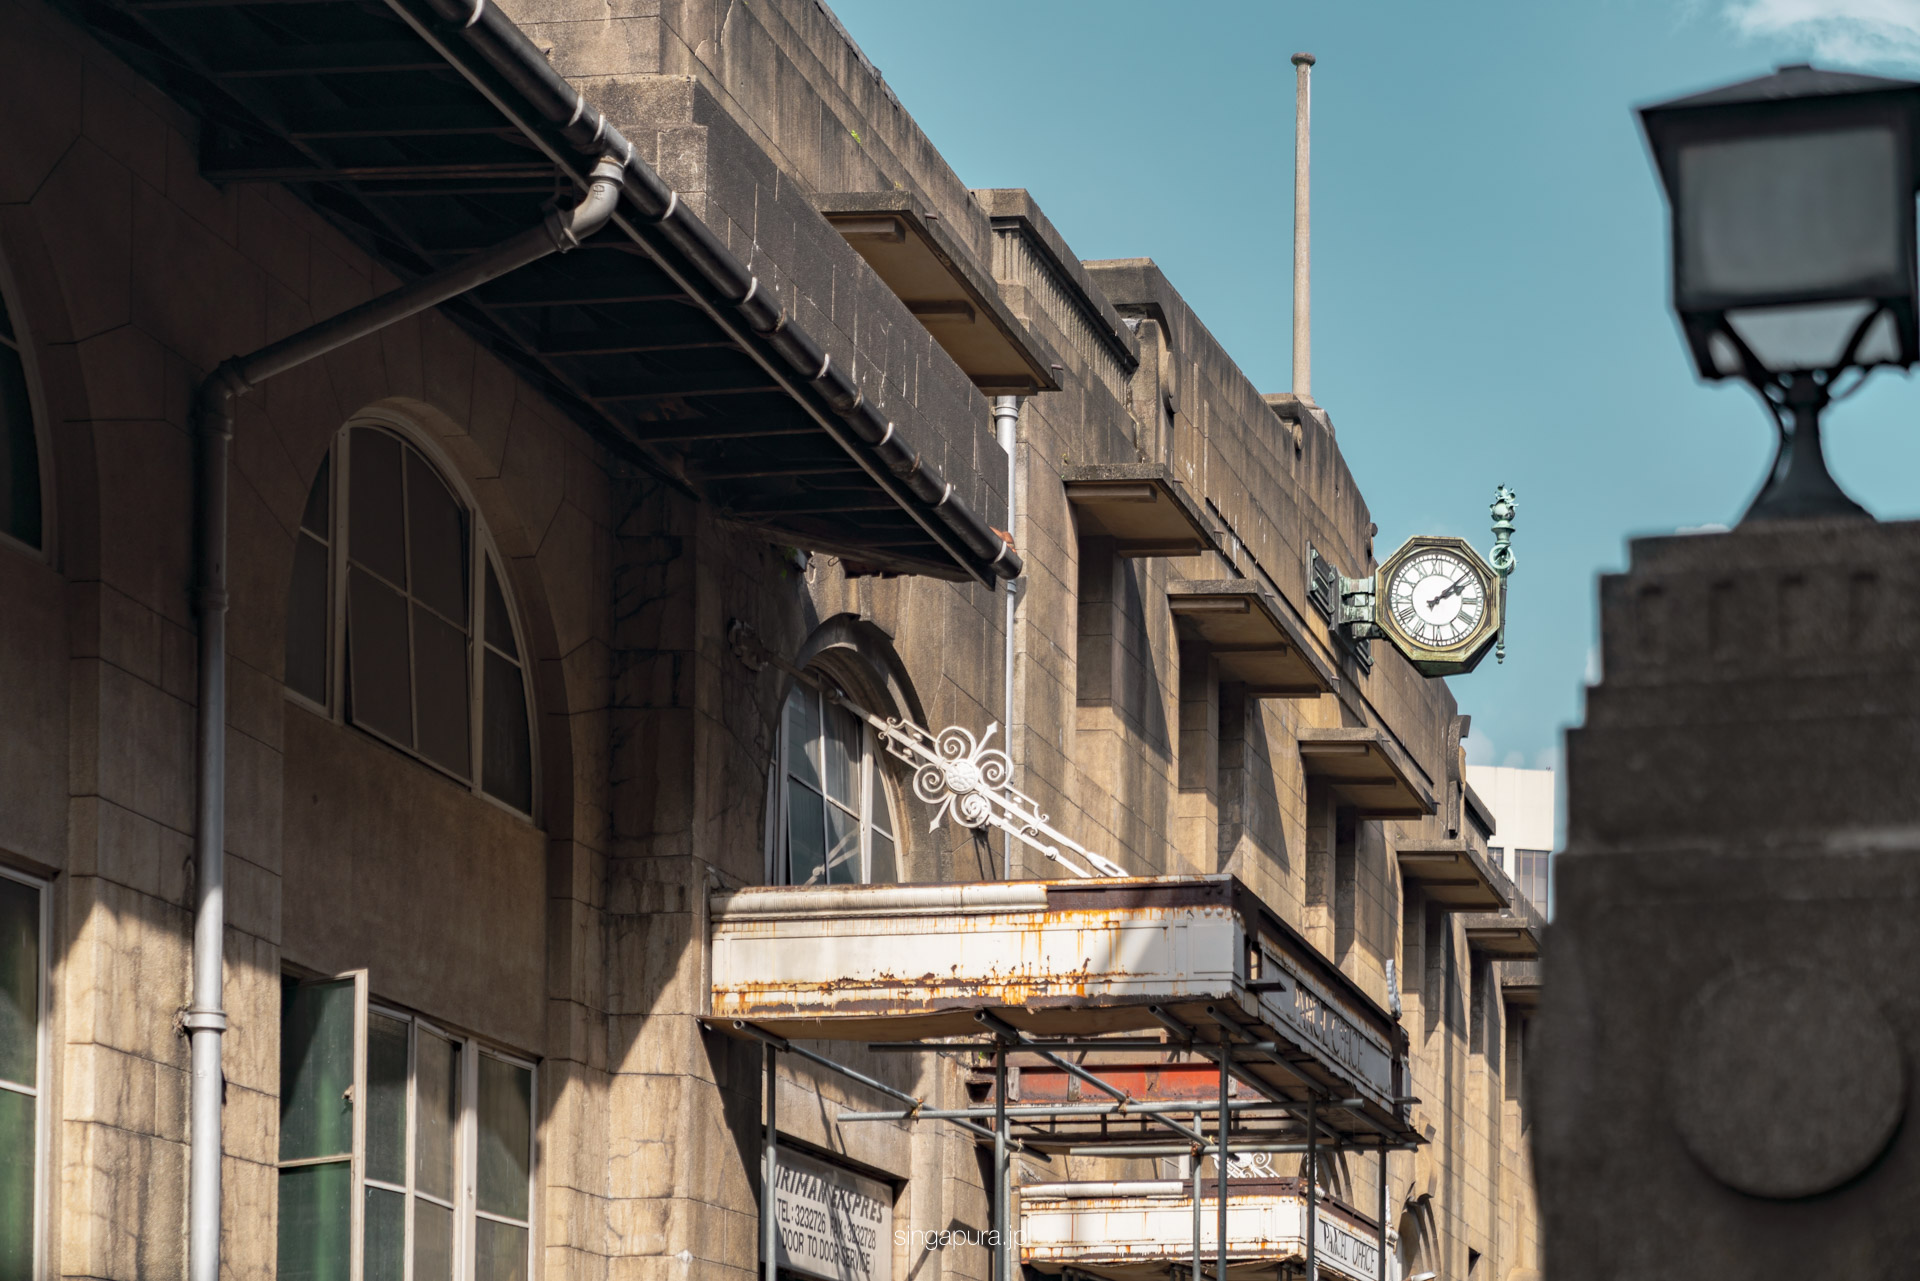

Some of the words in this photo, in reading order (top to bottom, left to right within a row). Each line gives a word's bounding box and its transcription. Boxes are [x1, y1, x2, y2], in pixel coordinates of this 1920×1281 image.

[775, 1164, 828, 1204] IRIMAN
[807, 1234, 818, 1258] TO
[819, 1240, 839, 1265] DOOR
[1323, 1223, 1347, 1261] PARCEL
[1352, 1237, 1375, 1274] OFFICE
